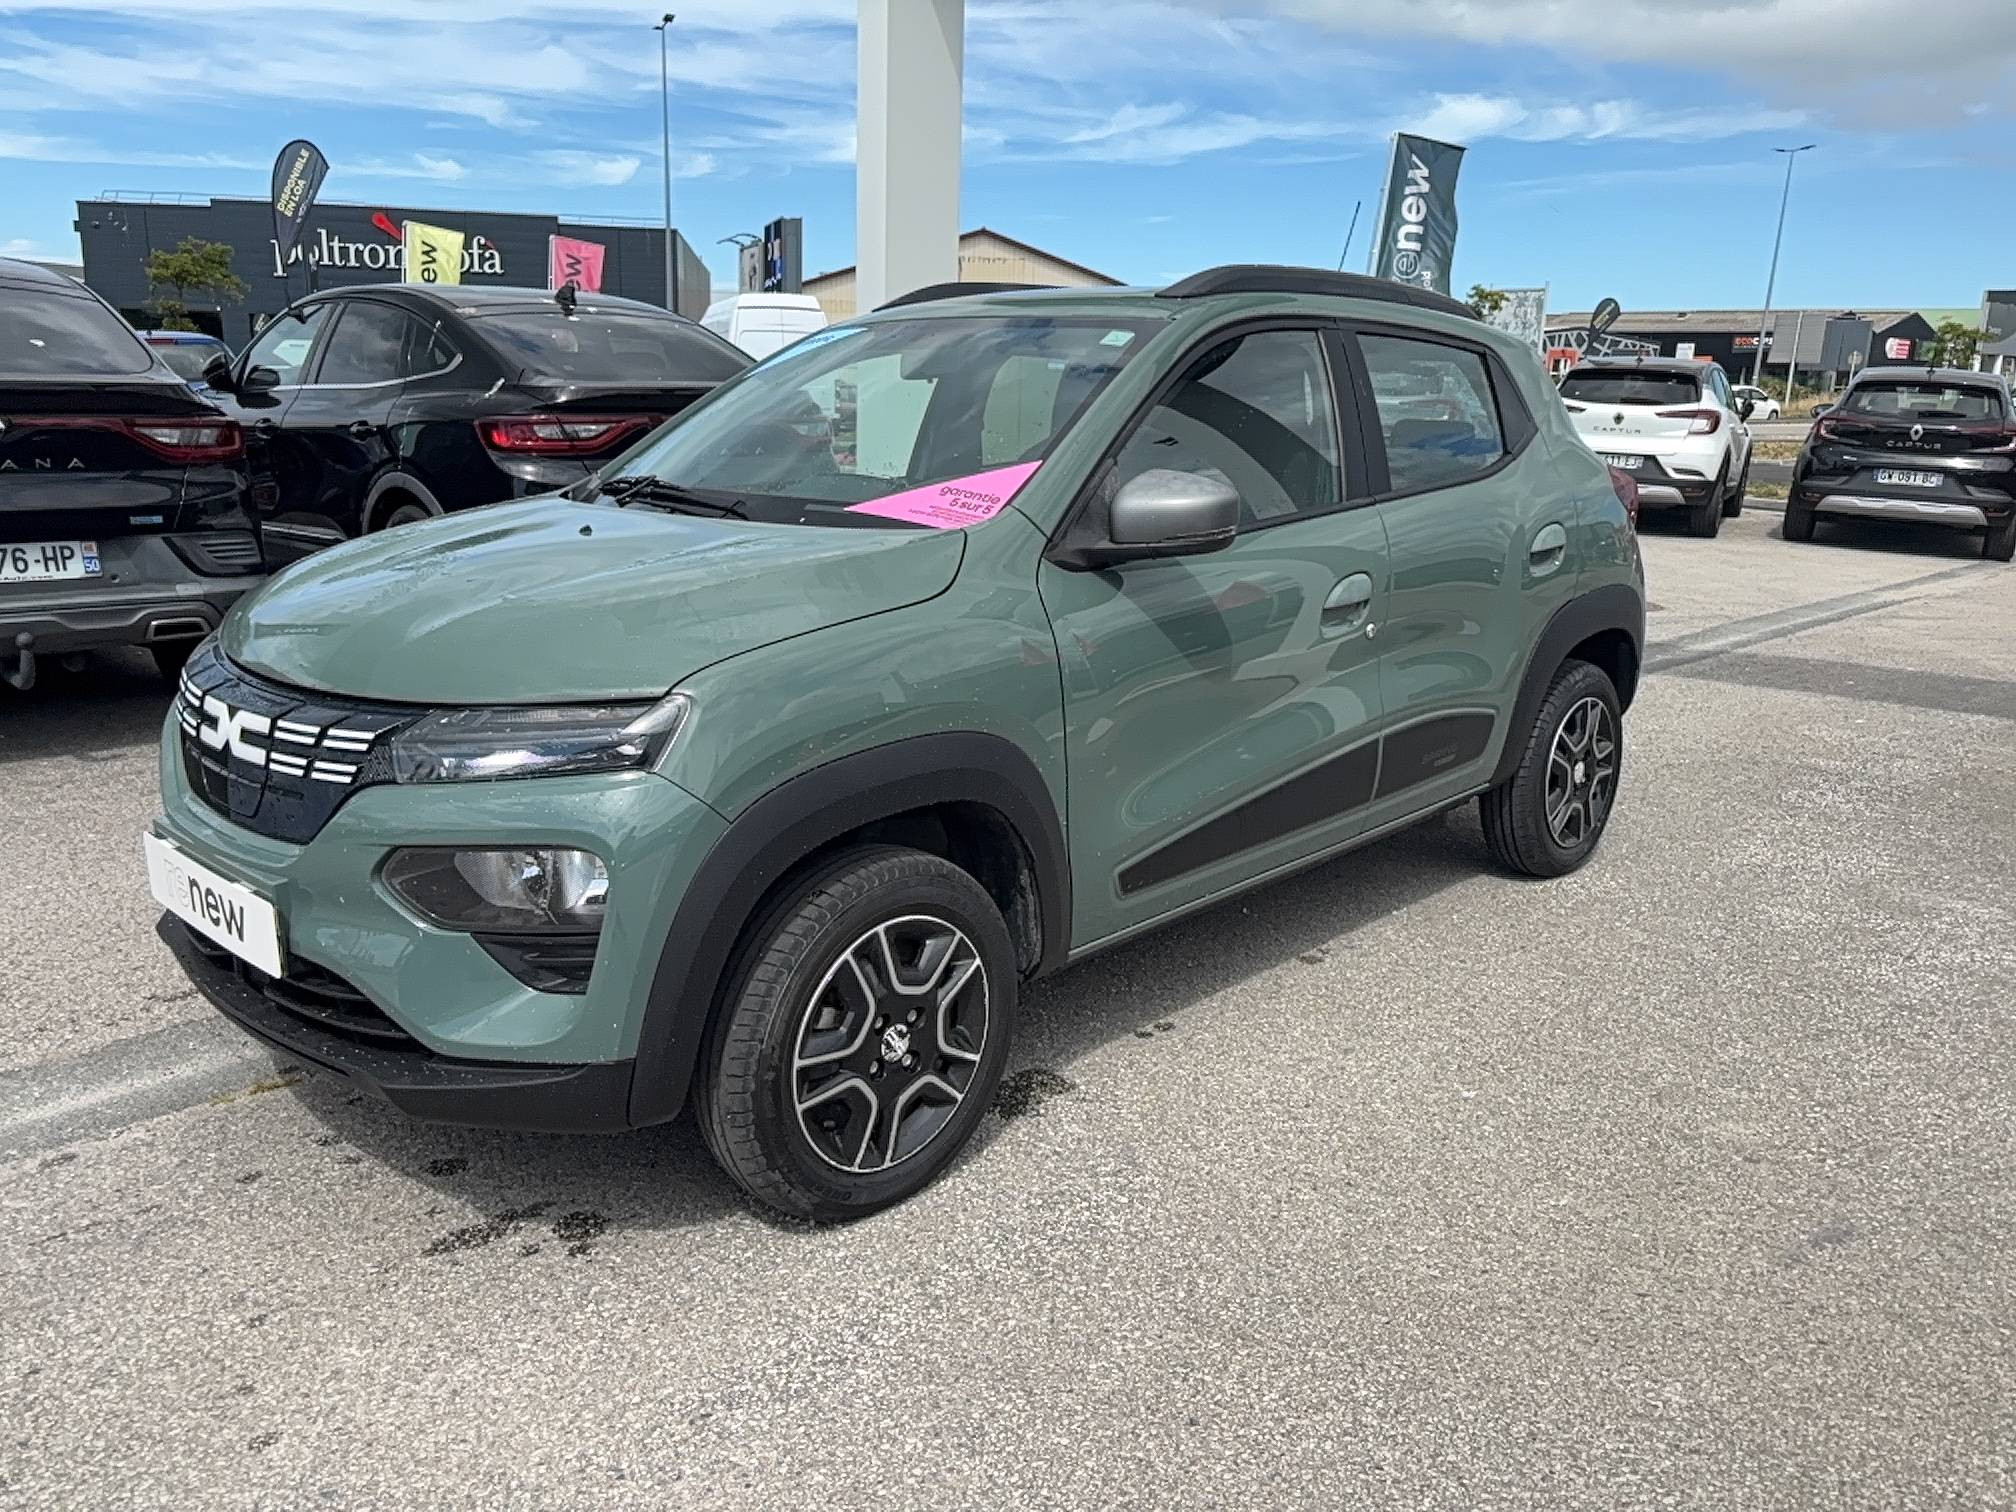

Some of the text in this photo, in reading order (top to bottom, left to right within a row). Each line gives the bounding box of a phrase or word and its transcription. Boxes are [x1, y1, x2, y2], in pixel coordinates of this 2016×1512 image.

[277, 148, 310, 212] DISPONIBLE
[290, 179, 307, 202] LOA
[284, 200, 297, 217] EN
[1593, 425, 1641, 434] CAPTUR
[1886, 440, 1942, 449] CAPTUR
[939, 486, 1001, 505] garantie
[949, 498, 995, 515] 5 sur 5
[85, 558, 100, 572] 50
